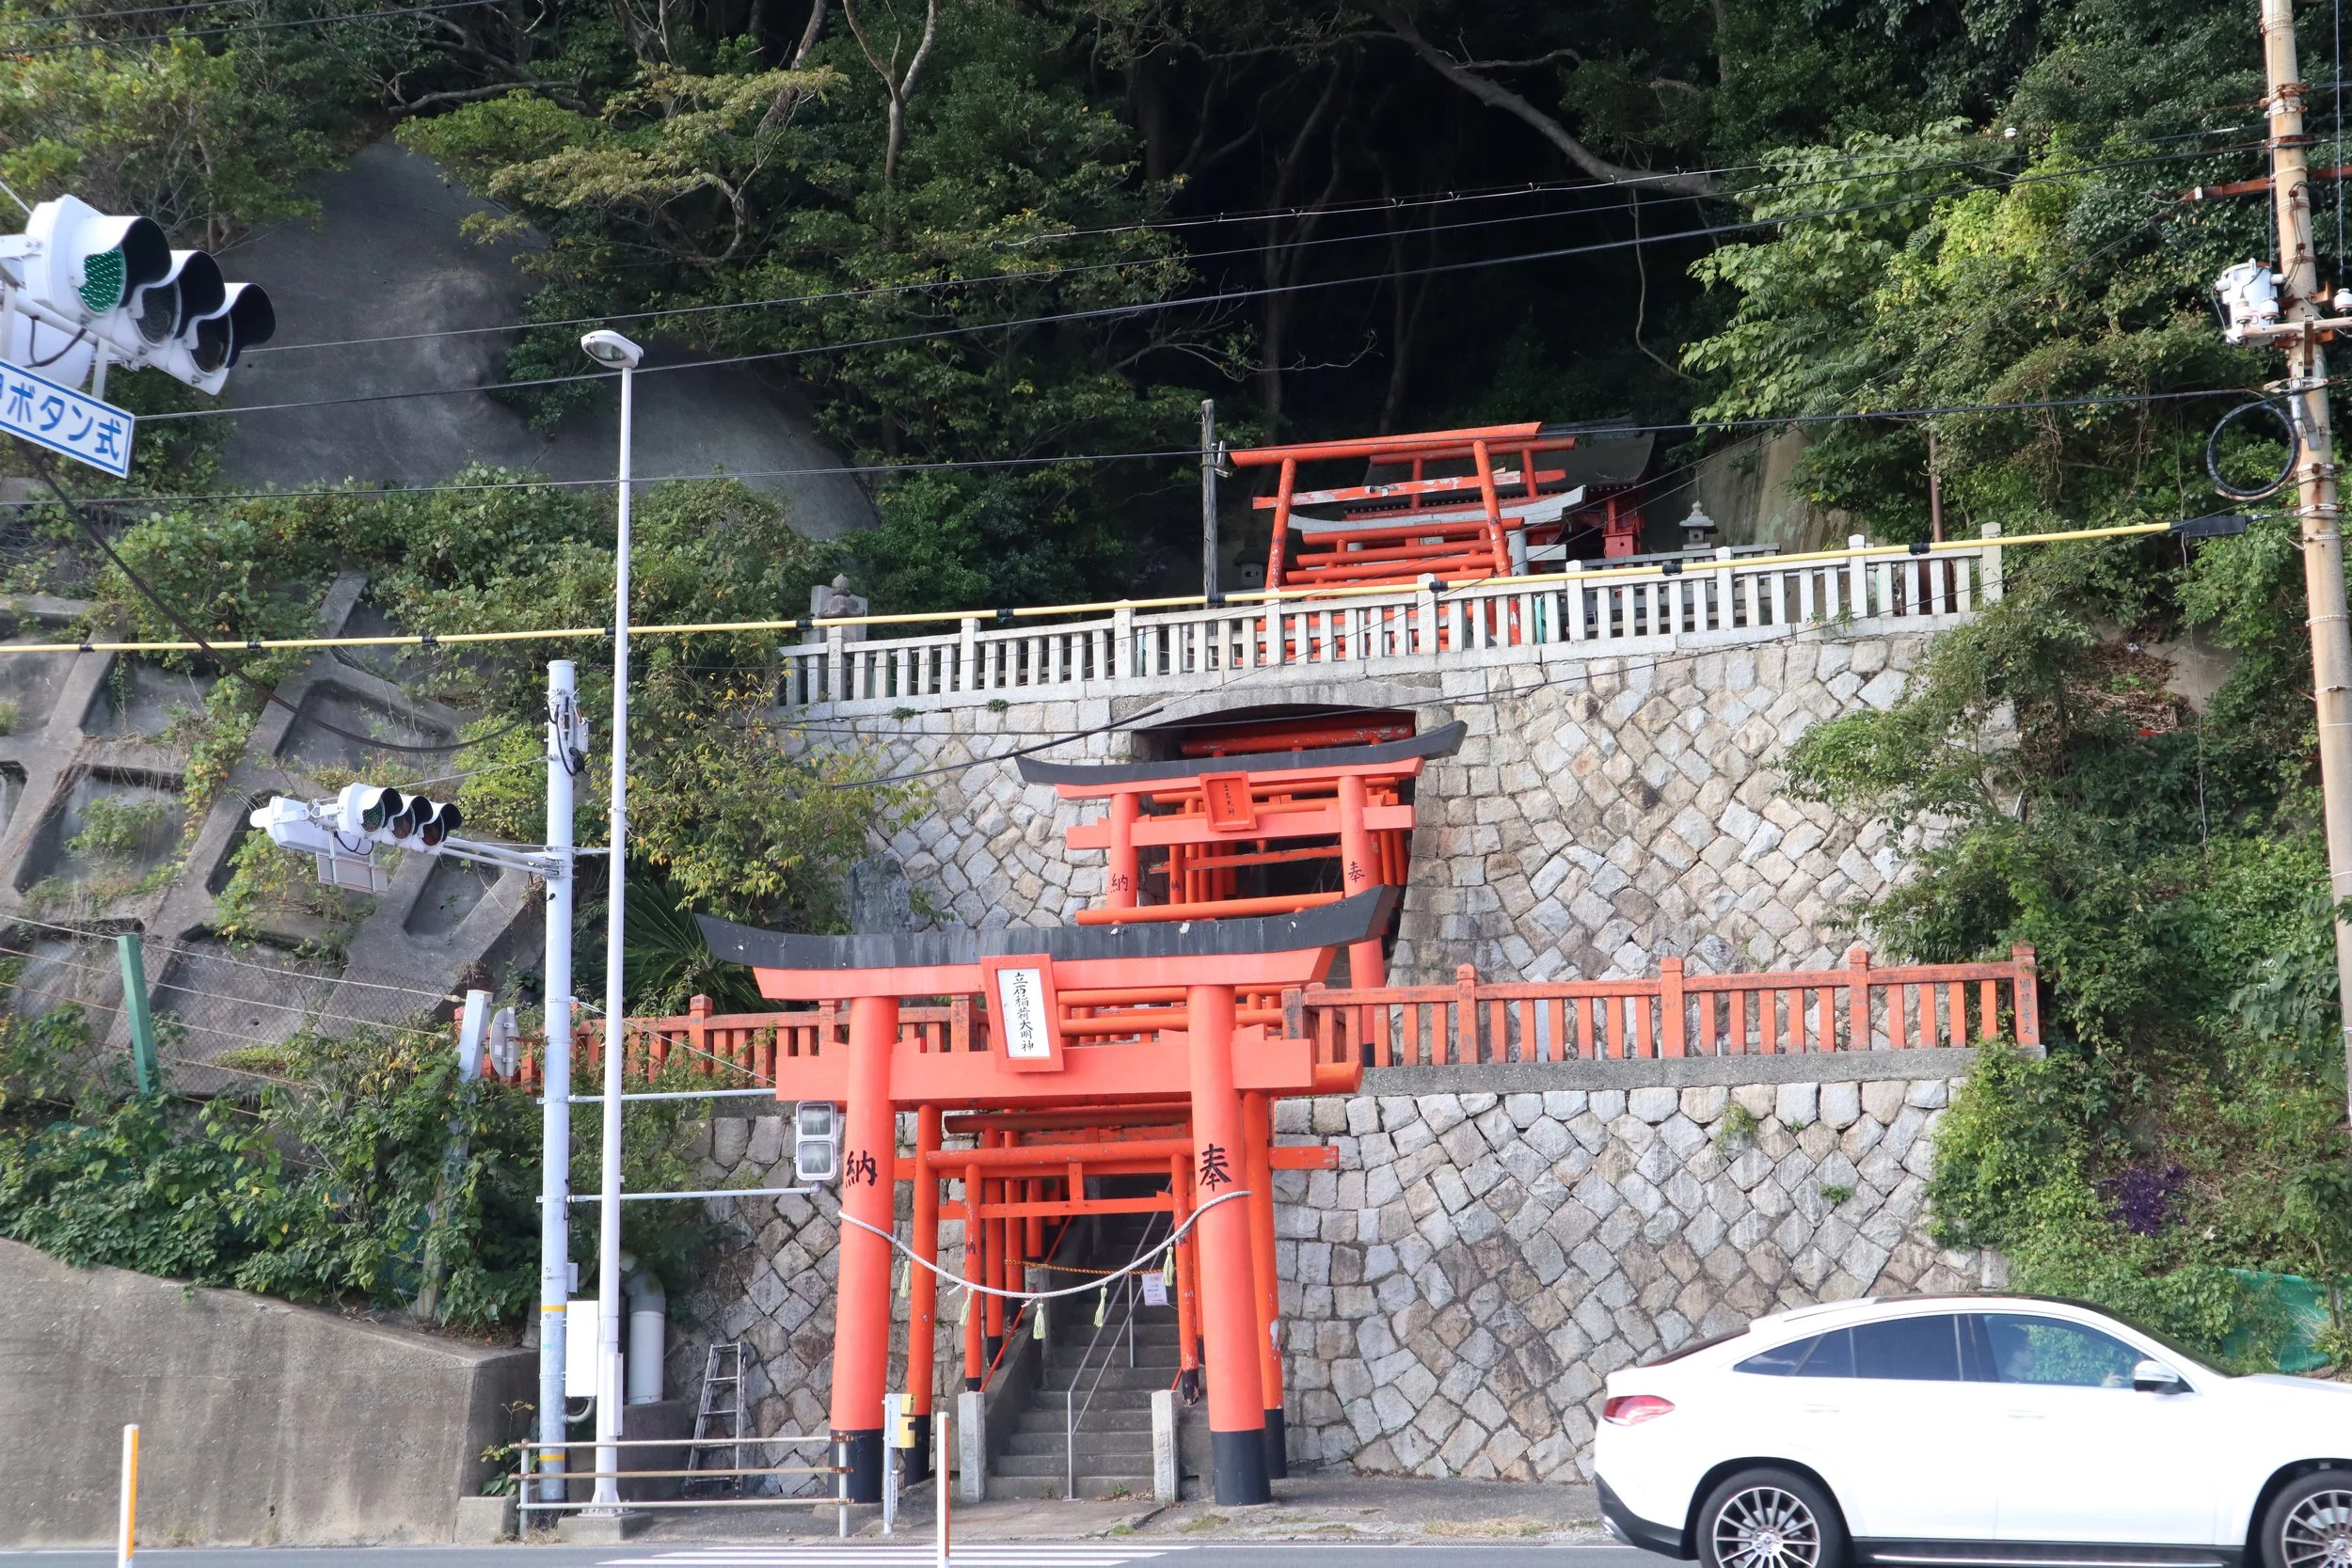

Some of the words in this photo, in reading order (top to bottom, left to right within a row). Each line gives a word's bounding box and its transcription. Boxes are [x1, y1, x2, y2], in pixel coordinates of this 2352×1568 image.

[1110, 873, 1129, 893] 納
[1348, 861, 1366, 883] 奉
[845, 1149, 878, 1189] 納
[1200, 1143, 1232, 1193] 奉
